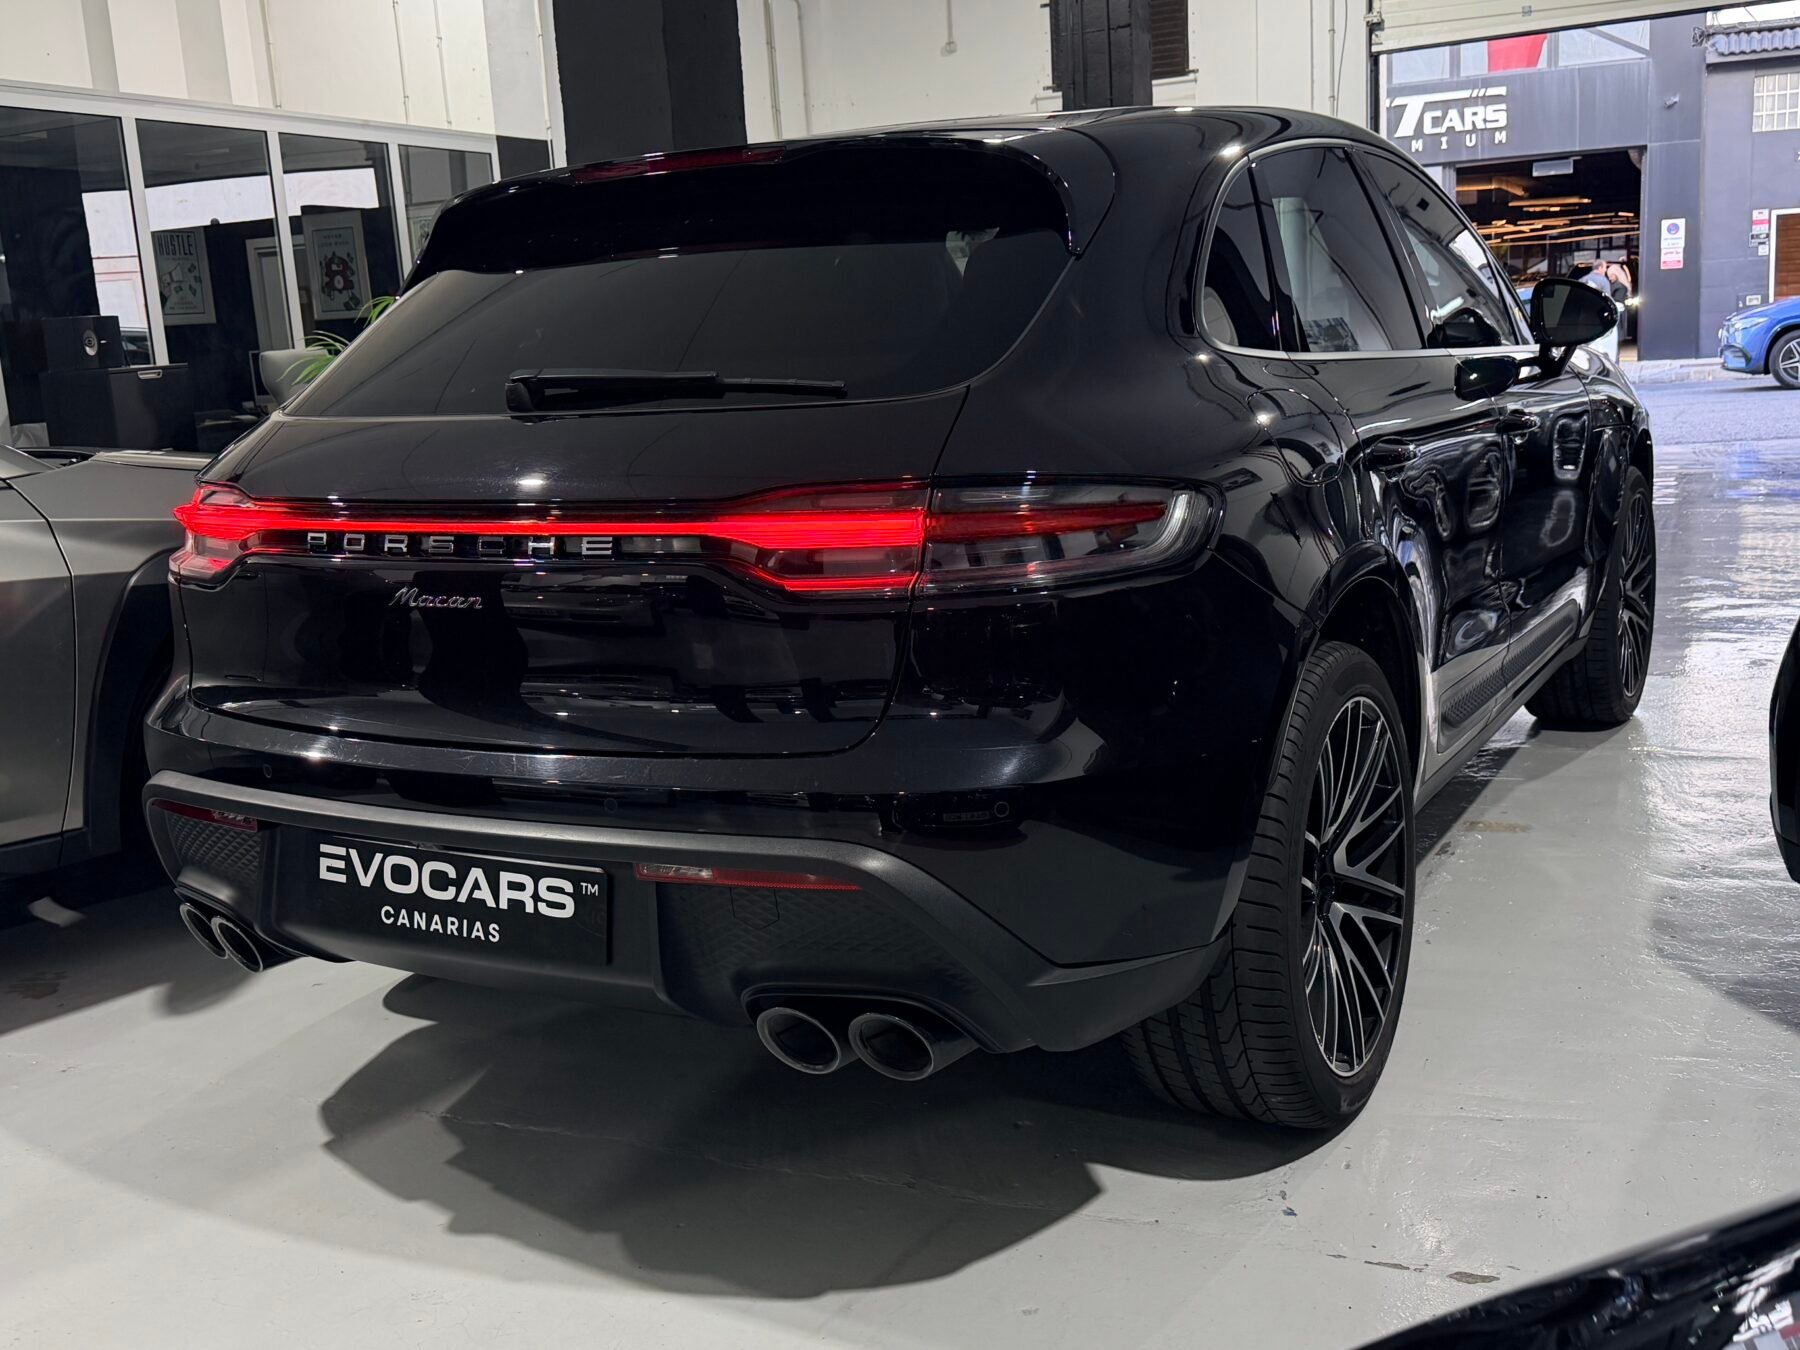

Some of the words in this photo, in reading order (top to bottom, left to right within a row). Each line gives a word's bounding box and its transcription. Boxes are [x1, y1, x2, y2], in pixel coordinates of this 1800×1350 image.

[157, 234, 194, 256] HUSTLE
[307, 532, 613, 555] PORSCHE
[388, 585, 483, 610] Macan
[319, 843, 576, 919] EVOCARS
[380, 905, 501, 943] CANARIAS
